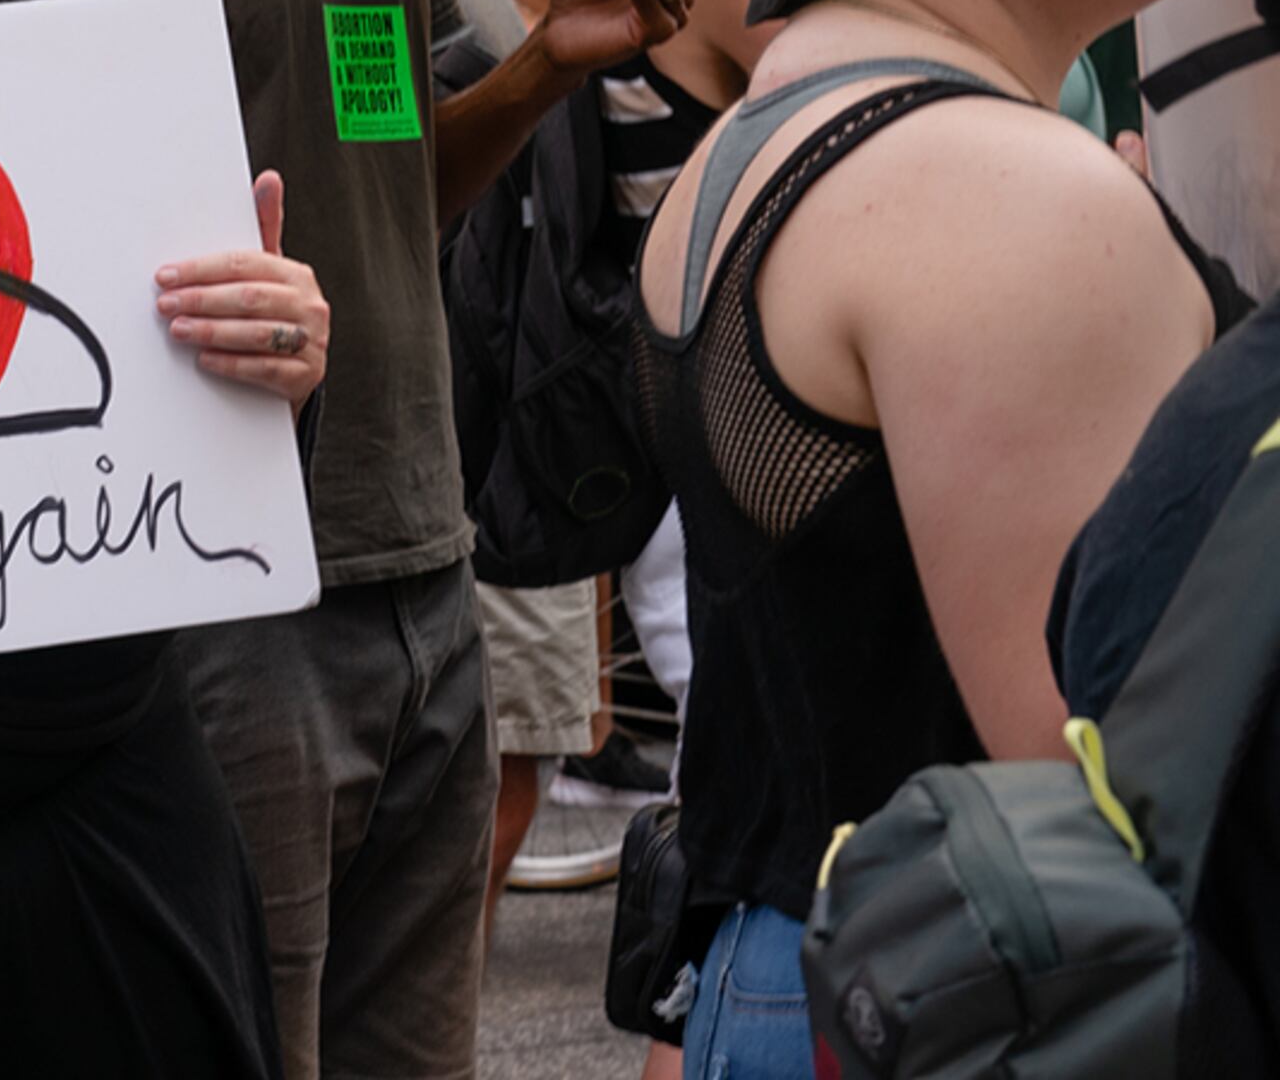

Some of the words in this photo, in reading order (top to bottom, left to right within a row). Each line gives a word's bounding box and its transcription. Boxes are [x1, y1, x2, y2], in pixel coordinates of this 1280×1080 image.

[331, 10, 394, 38] ABORTION
[349, 39, 397, 61] DEMAND
[344, 61, 397, 86] WITHOUT
[340, 87, 404, 115] APOLOGY!
